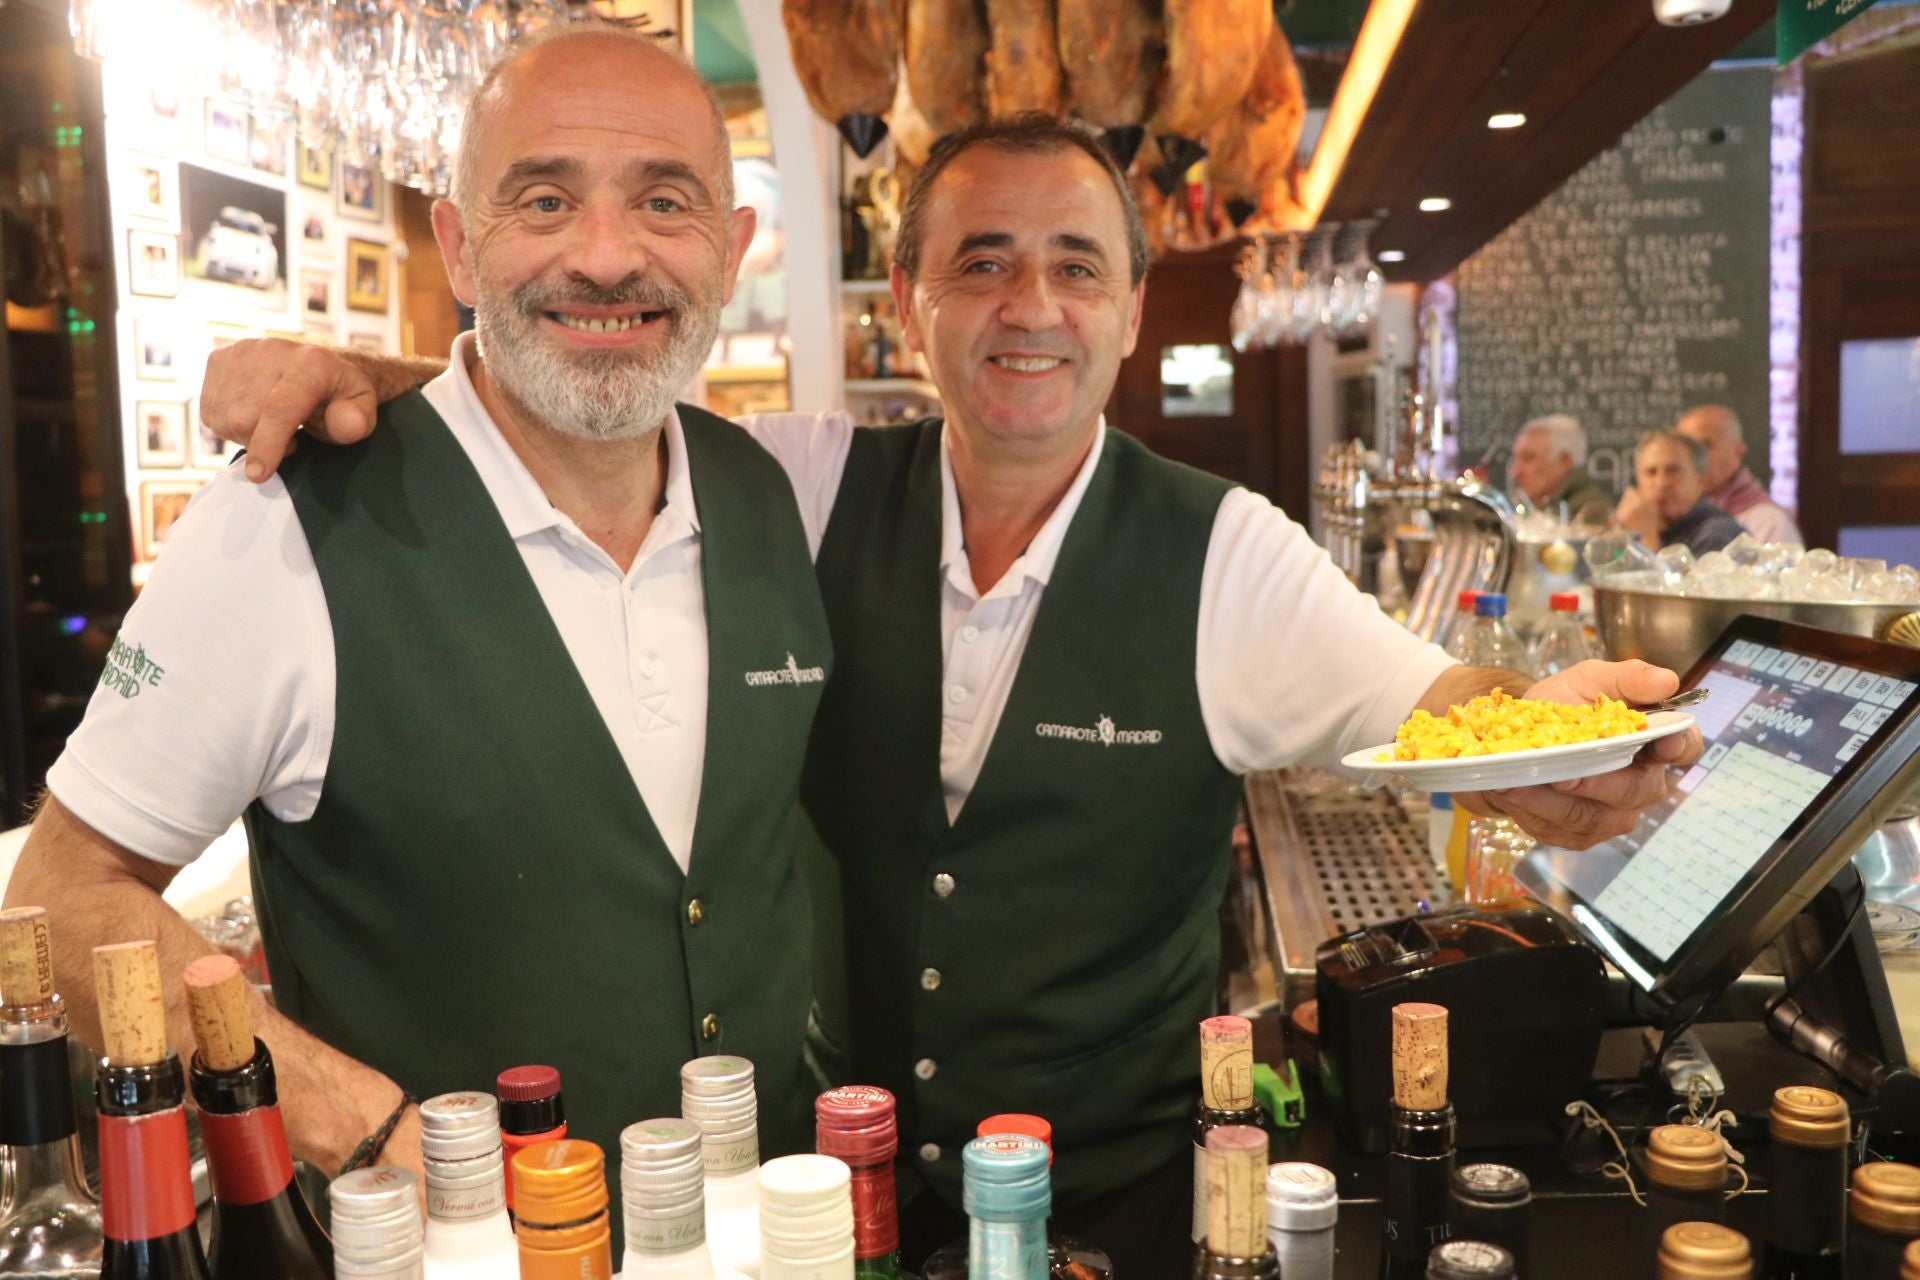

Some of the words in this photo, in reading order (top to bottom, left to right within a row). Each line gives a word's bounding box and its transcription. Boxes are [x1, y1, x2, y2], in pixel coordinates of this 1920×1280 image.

[745, 669, 794, 685] CAMAROTE
[1035, 723, 1099, 742] CAMAROTE
[1116, 729, 1162, 743] MADRID
[827, 1090, 886, 1103] MARTINI
[972, 1141, 1043, 1151] MARTINI
